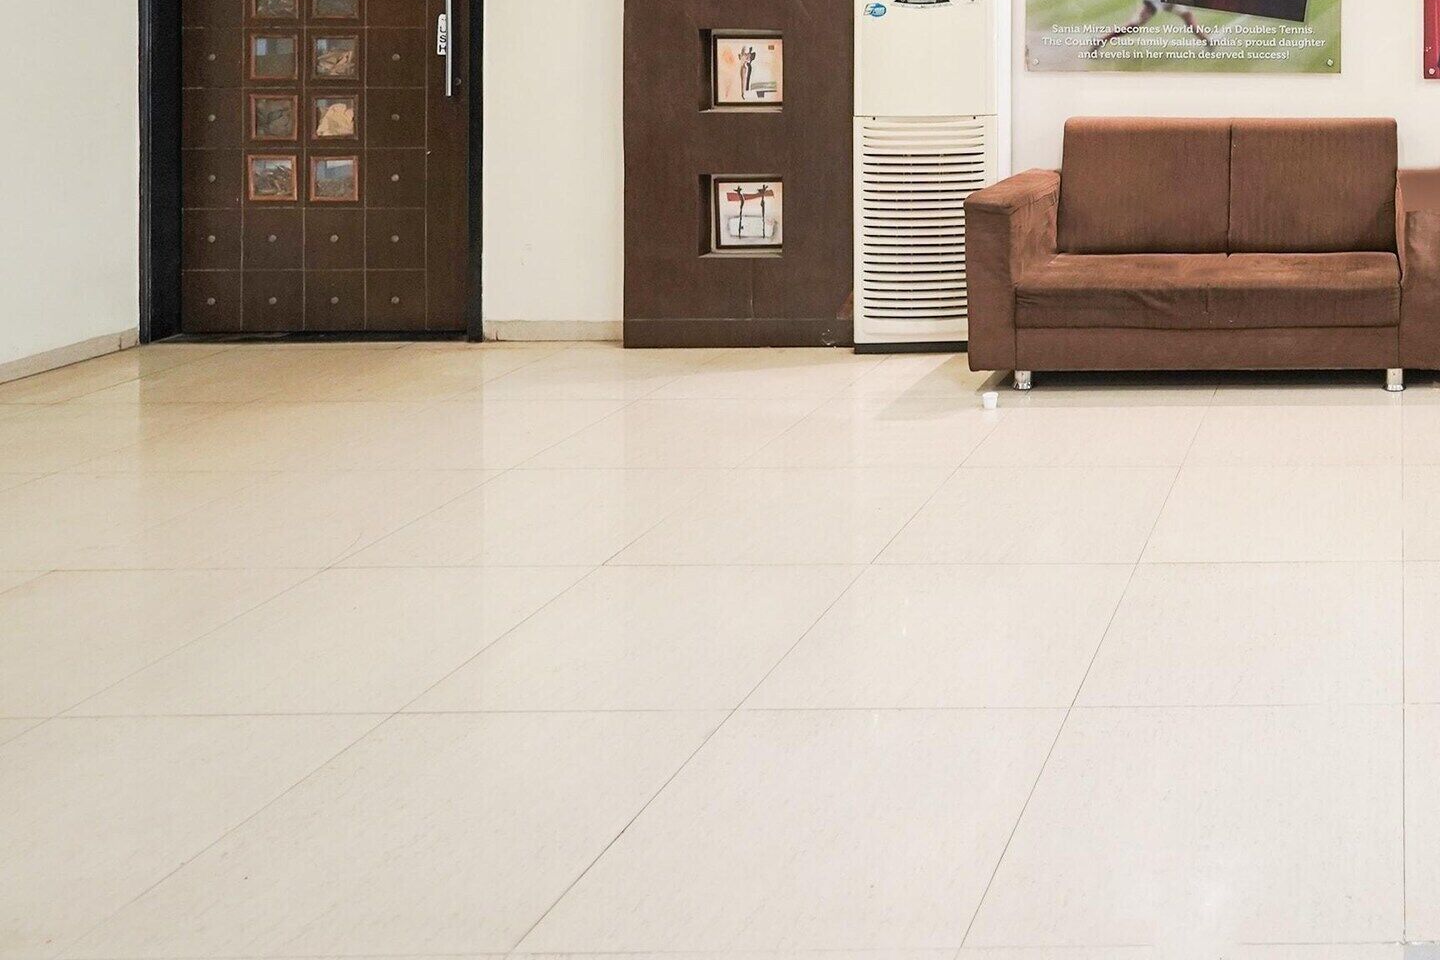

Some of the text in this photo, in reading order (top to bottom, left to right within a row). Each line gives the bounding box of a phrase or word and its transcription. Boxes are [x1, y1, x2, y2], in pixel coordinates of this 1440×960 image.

[1051, 24, 1080, 33] Sania
[1083, 24, 1112, 33] Mirza
[1114, 24, 1160, 34] becomes
[1162, 24, 1193, 34] World
[1221, 24, 1232, 34] in
[1235, 25, 1277, 34] Doubles
[1042, 37, 1062, 46] The
[1064, 37, 1108, 48] Country
[1109, 37, 1134, 46] Club
[1136, 37, 1168, 48] family
[1170, 37, 1208, 47] salutes
[1245, 38, 1276, 48] proud
[1278, 38, 1326, 49] daughter
[1078, 50, 1290, 59] and revels in her much deserved success!
